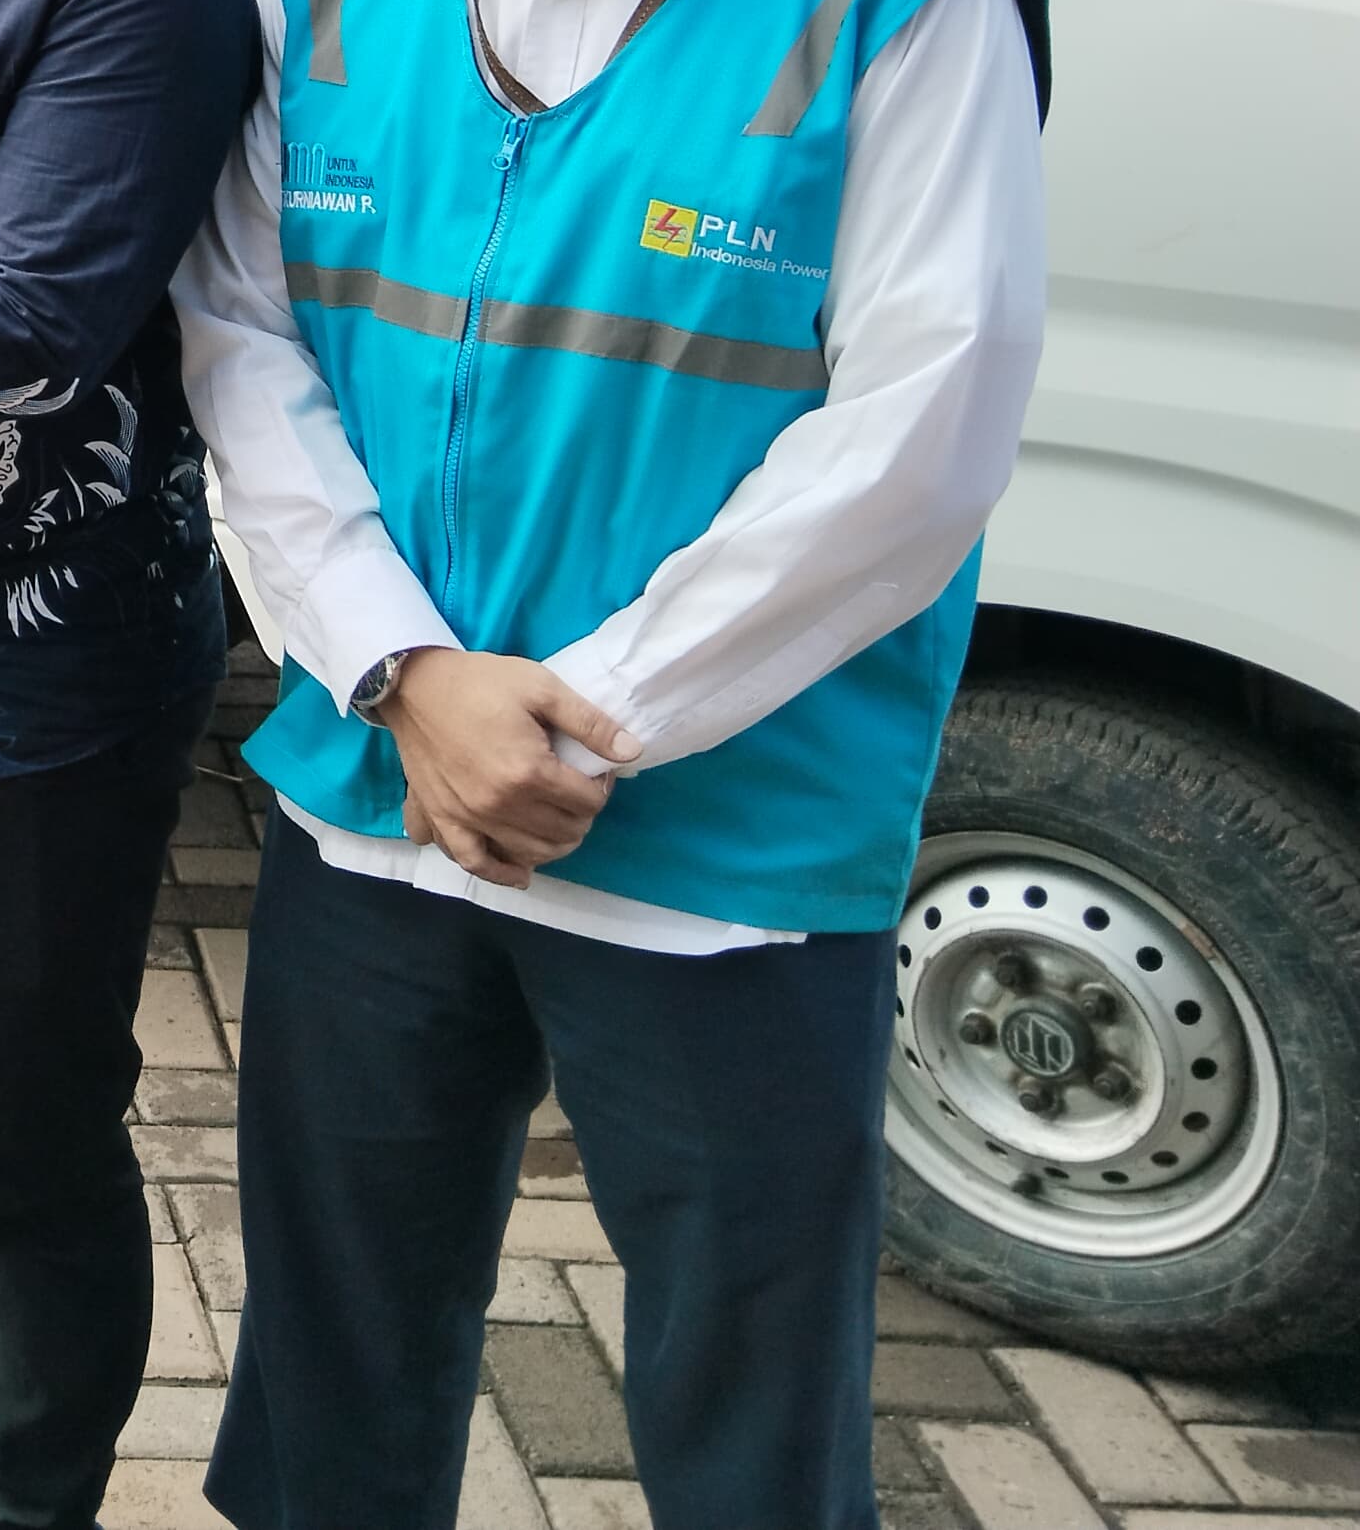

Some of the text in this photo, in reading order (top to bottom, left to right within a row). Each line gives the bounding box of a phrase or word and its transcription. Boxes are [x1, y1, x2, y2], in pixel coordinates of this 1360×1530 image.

[325, 173, 375, 190] INDONESIA
[699, 214, 776, 252] PLN
[691, 242, 830, 281] Indonesia Power
